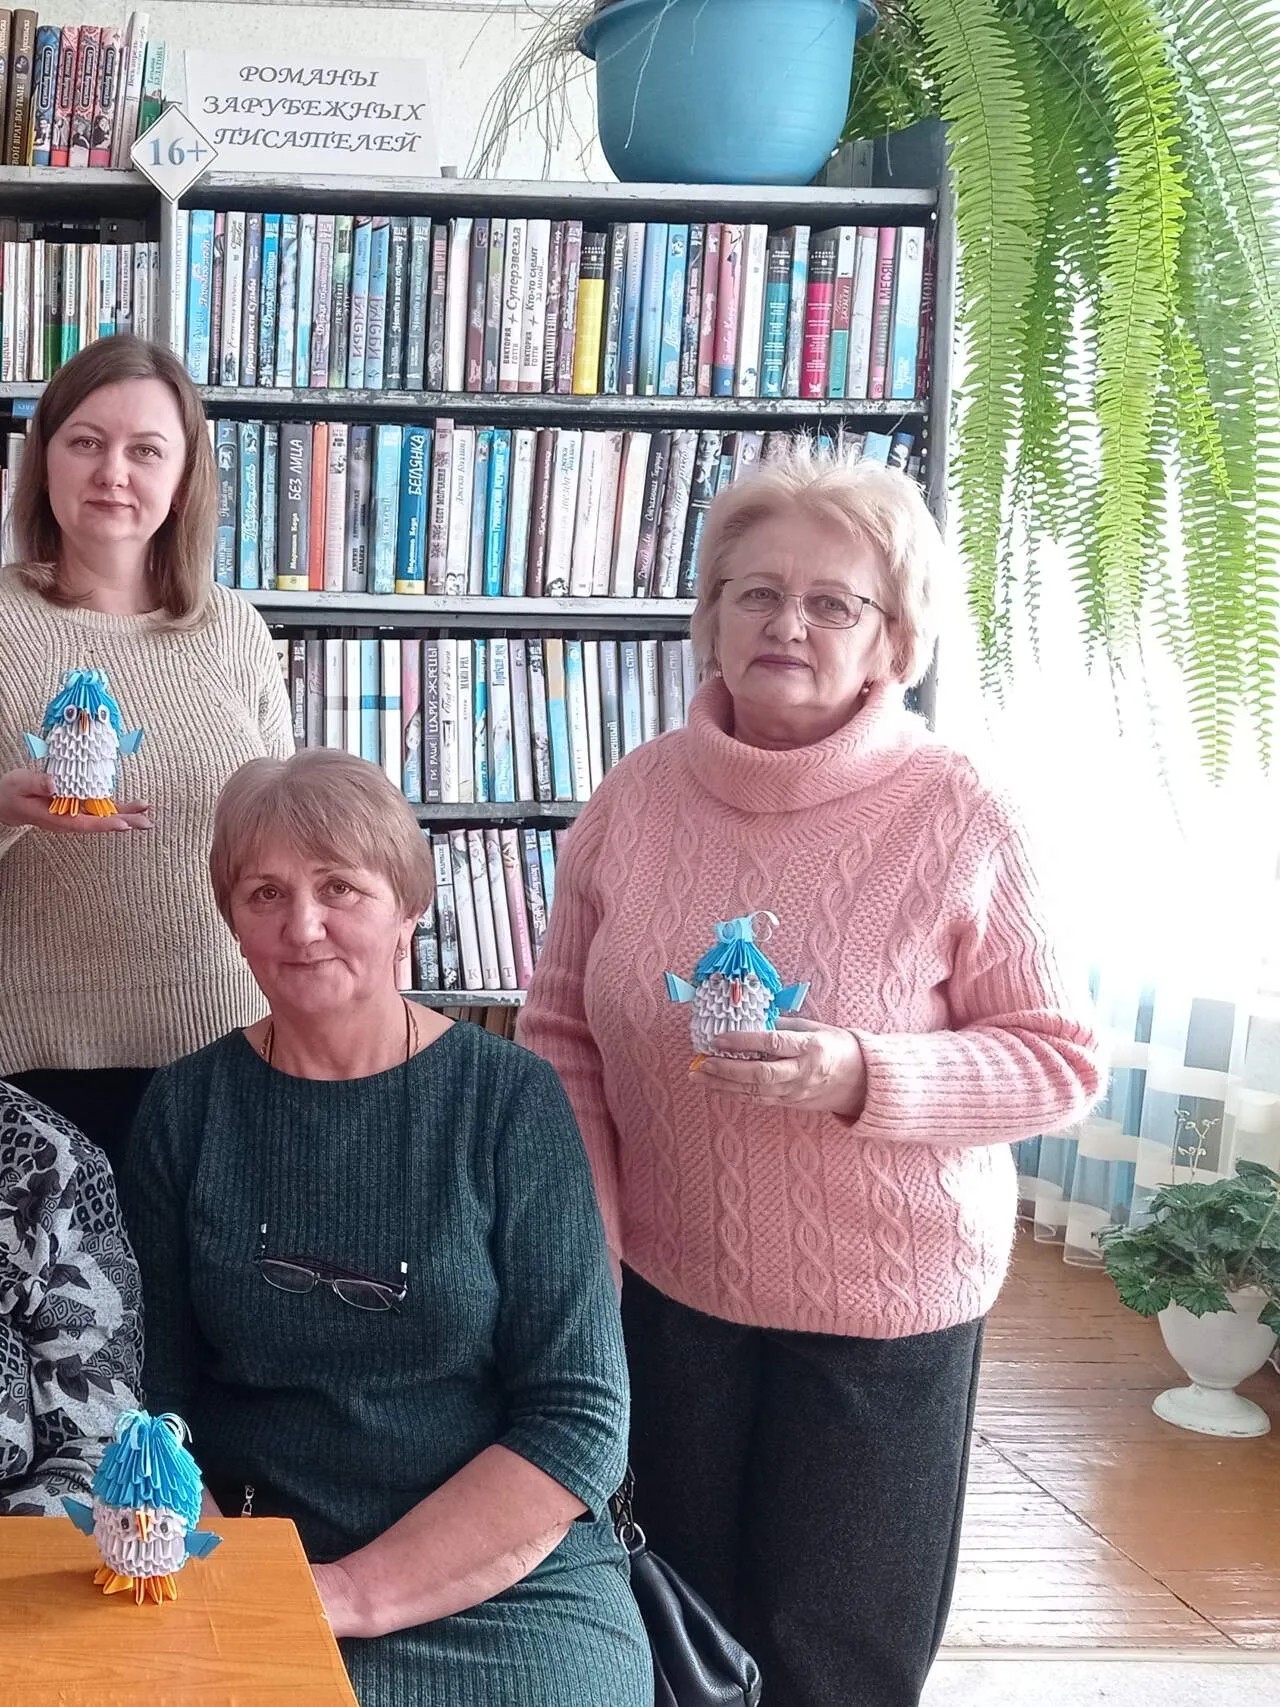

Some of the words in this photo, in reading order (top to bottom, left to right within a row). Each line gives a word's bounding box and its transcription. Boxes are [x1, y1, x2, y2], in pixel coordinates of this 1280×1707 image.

[239, 65, 379, 88] РОМАНЫ
[16, 84, 24, 106] ТЬМЕ
[202, 95, 426, 121] ЗАРУБЕЖНЫХ
[13, 123, 21, 143] ВРАГ
[213, 126, 422, 153] ПИСАТЕЛЕЙ
[148, 138, 208, 166] 16+
[506, 227, 522, 310] Суперзвезда
[880, 258, 894, 300] МЕСЯЦ
[248, 278, 257, 312] Судьбы
[246, 314, 255, 374] Превратности
[503, 327, 511, 364] ВИКТОРИЯ
[511, 343, 519, 364] ГОТТИ
[523, 331, 532, 366] ВИКТОРИЯ
[530, 346, 539, 366] ГОТТИ
[290, 440, 303, 474] ЛИЦА
[408, 434, 425, 496] БЕГЛЯНКА
[289, 478, 302, 500] БЕЗ
[427, 647, 438, 733] ЦАРИ-ЖРЕЦЫ
